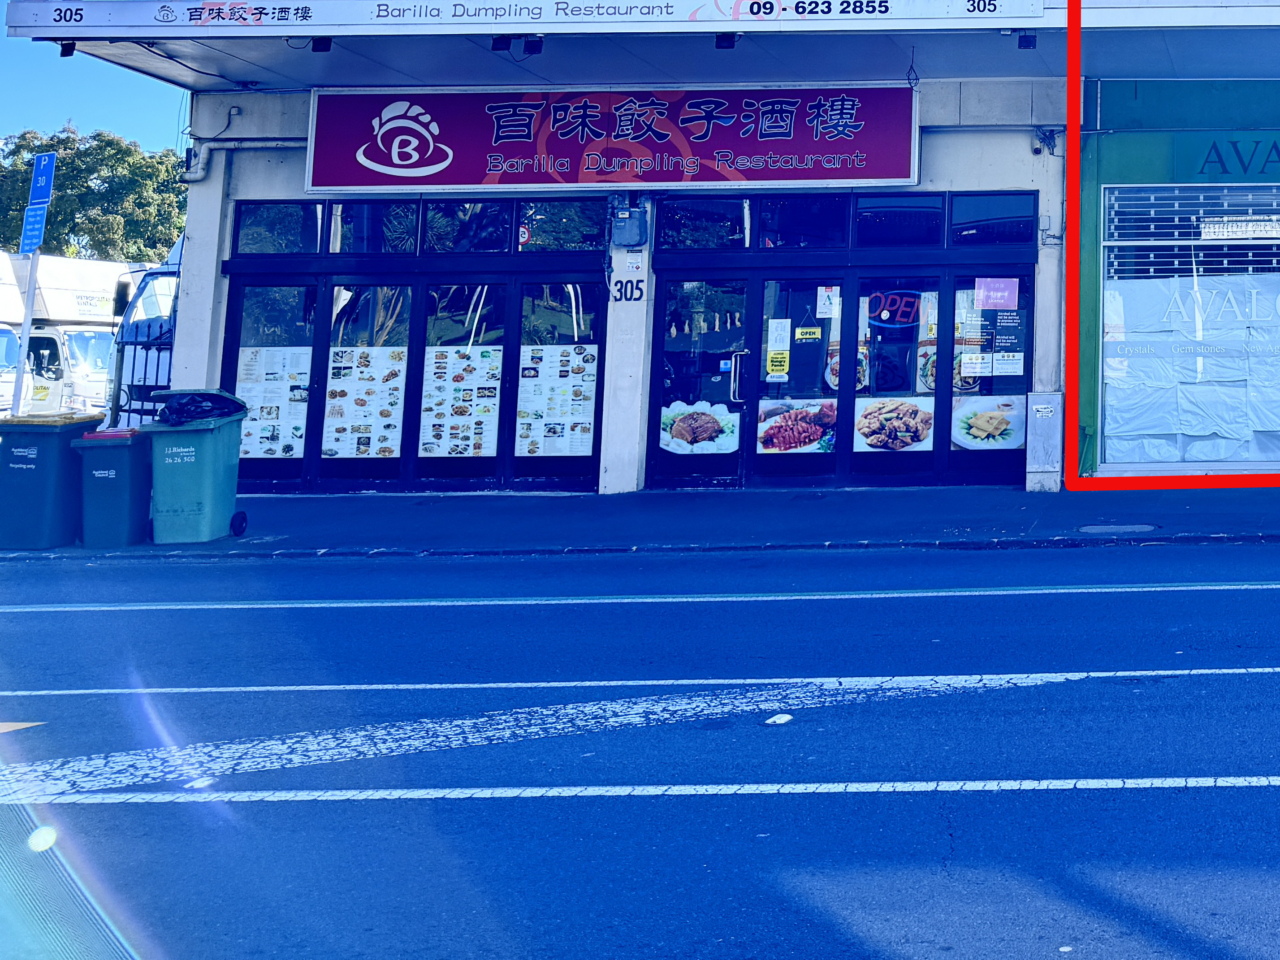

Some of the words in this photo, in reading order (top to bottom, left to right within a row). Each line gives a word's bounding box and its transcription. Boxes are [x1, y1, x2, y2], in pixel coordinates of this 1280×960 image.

[53, 7, 84, 23] 305
[186, 5, 313, 23] 百味餃子酒樓
[376, 3, 441, 19] Barilla
[452, 3, 543, 20] Dumpling
[554, 1, 675, 17] Restaurant
[749, 1, 775, 15] 09
[794, 0, 833, 15] 623
[839, 0, 890, 14] 2855
[485, 93, 866, 147] 百味餃子酒樓
[41, 156, 49, 170] P
[486, 153, 571, 174] Barilla
[583, 152, 700, 175] Dumpling
[713, 150, 867, 170] Restaurant
[37, 176, 46, 187] 30
[614, 280, 644, 302] 305
[823, 294, 833, 306] A
[866, 292, 931, 326] OPEN
[1117, 344, 1155, 355] Crystals
[1171, 344, 1194, 353] Gem
[1197, 345, 1226, 353] stones
[1242, 343, 1265, 353] New
